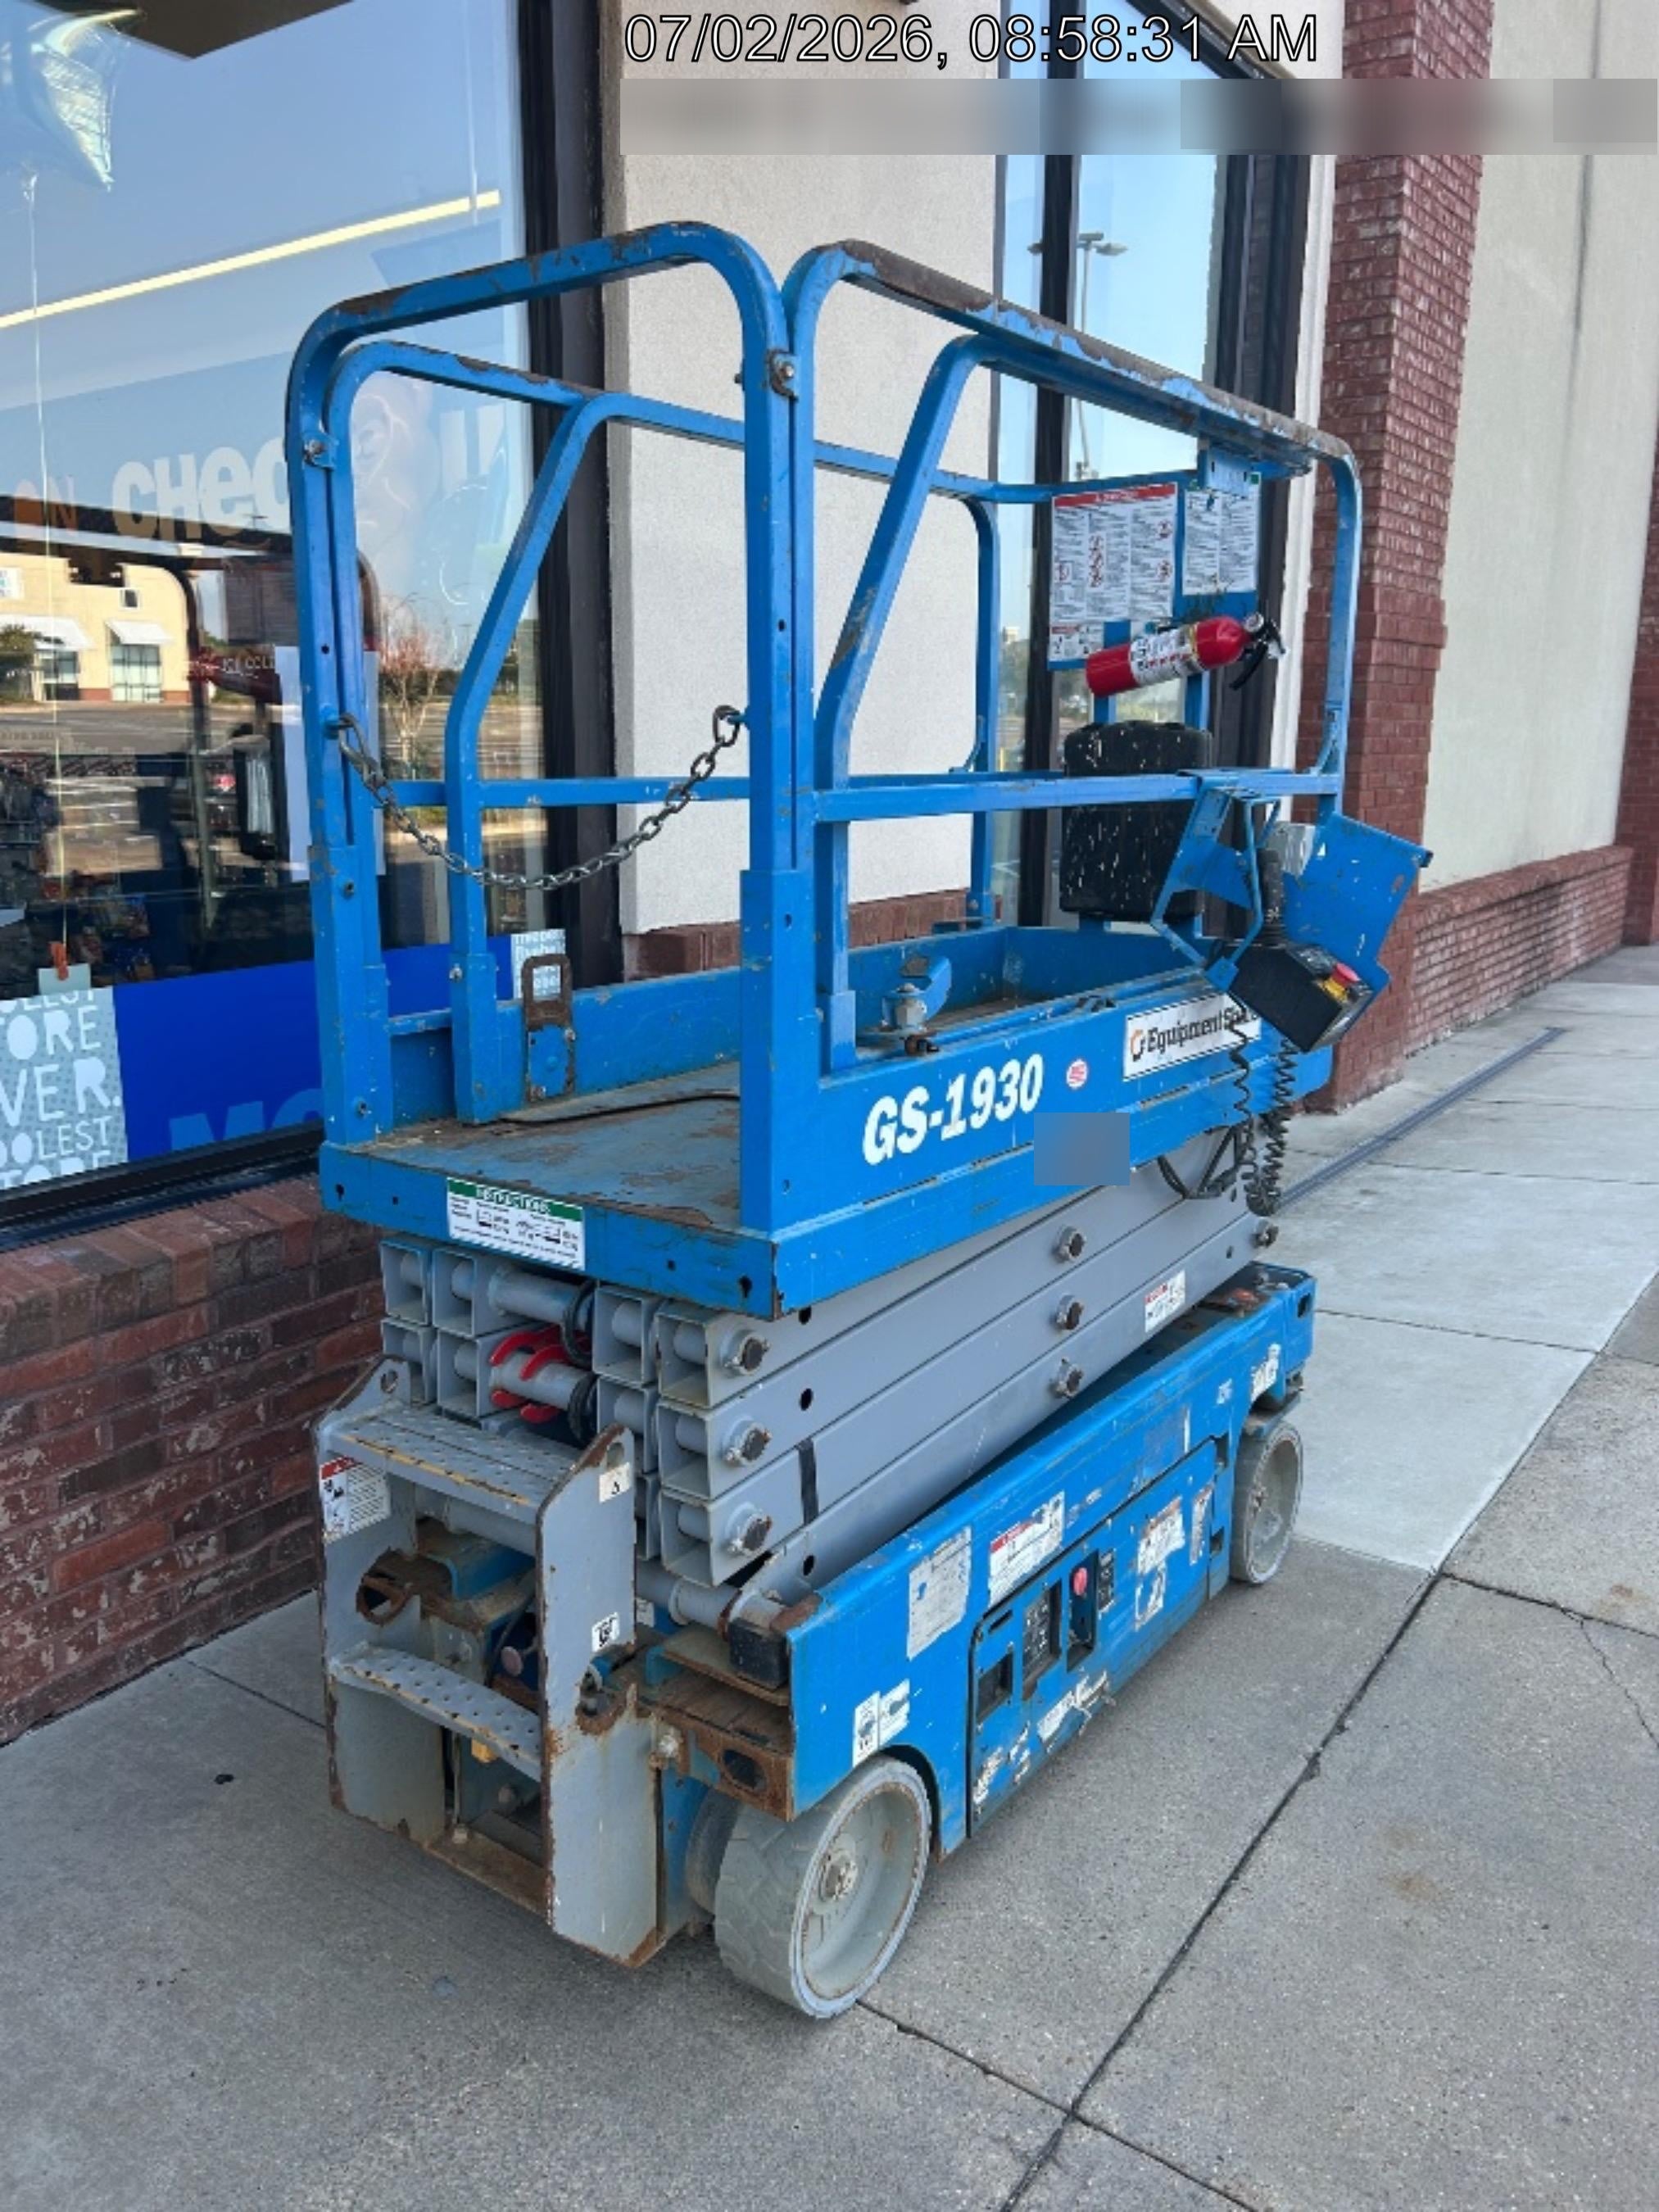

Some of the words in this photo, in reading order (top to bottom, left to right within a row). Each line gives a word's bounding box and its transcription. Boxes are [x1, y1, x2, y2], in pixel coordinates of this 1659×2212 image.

[0, 1004, 101, 1060] ORE
[0, 1056, 122, 1127] VER.
[863, 1054, 1044, 1166] GS-1930
[0, 1115, 112, 1167] OLEST
